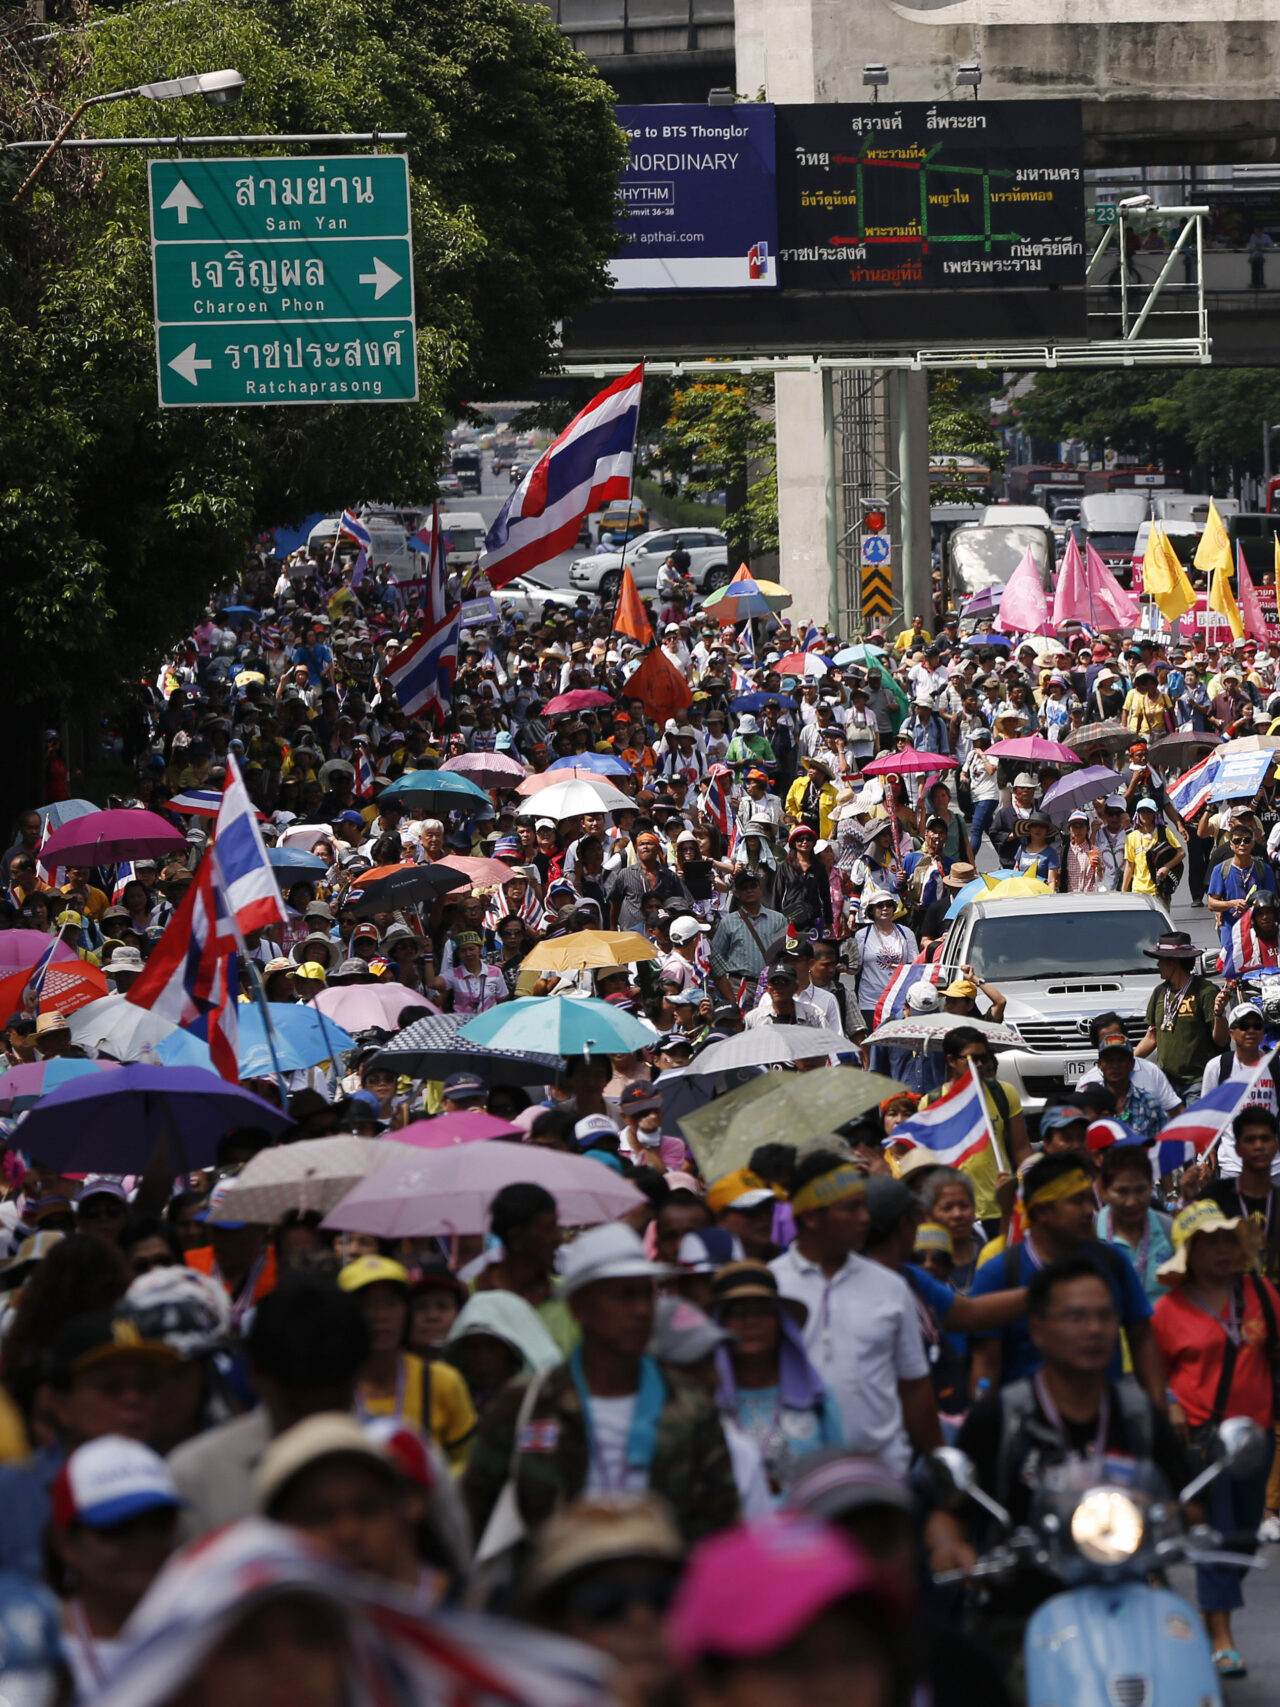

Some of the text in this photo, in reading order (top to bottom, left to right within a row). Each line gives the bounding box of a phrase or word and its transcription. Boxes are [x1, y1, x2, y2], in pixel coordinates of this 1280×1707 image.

[645, 127, 658, 138] to
[663, 126, 687, 138] BTS
[691, 125, 749, 140] Thonglor
[622, 153, 739, 171] NORDINARY
[795, 146, 829, 172] วิทยุ
[1016, 168, 1080, 181] มหานคร
[235, 165, 374, 206] สามย่าน
[614, 187, 669, 201] RHYTHM
[1096, 207, 1116, 221] 23
[266, 216, 347, 231] Sam Yan
[640, 231, 705, 244] apthai.com
[779, 243, 867, 261] ราชประสงค์
[191, 249, 325, 294] เจริญผล
[943, 259, 1041, 273] เพชรพระราม
[194, 298, 325, 314] Charoen Phon
[225, 329, 405, 370] ราชประสงค์
[246, 380, 382, 395] Ratchaprasong
